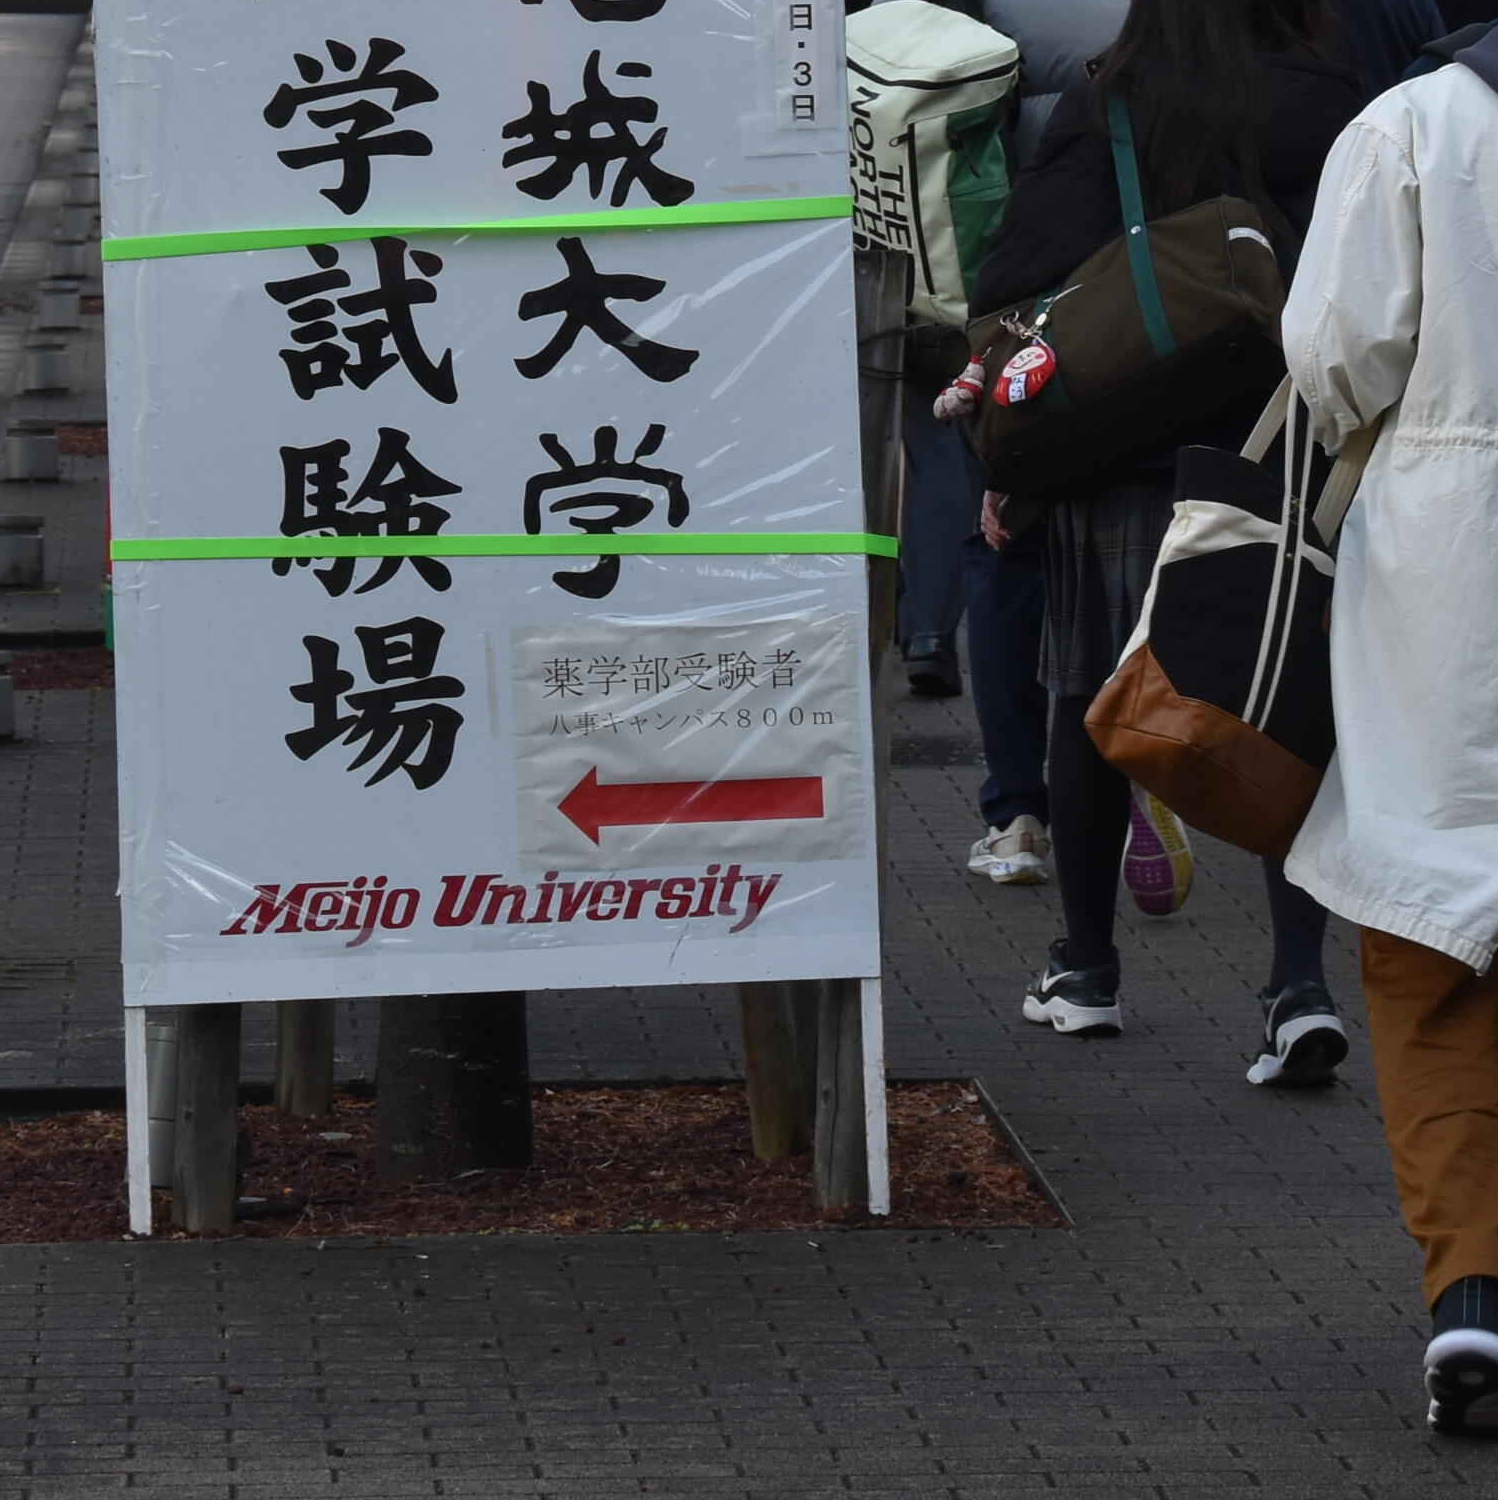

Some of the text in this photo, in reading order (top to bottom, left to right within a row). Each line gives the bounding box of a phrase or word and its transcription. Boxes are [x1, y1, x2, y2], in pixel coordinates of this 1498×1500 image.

[850, 86, 887, 244] NORTH
[879, 164, 912, 250] THE
[542, 648, 802, 699] 薬学部受験者
[549, 706, 835, 736] 八事キャンパス800m
[219, 863, 784, 949] Meijo University
